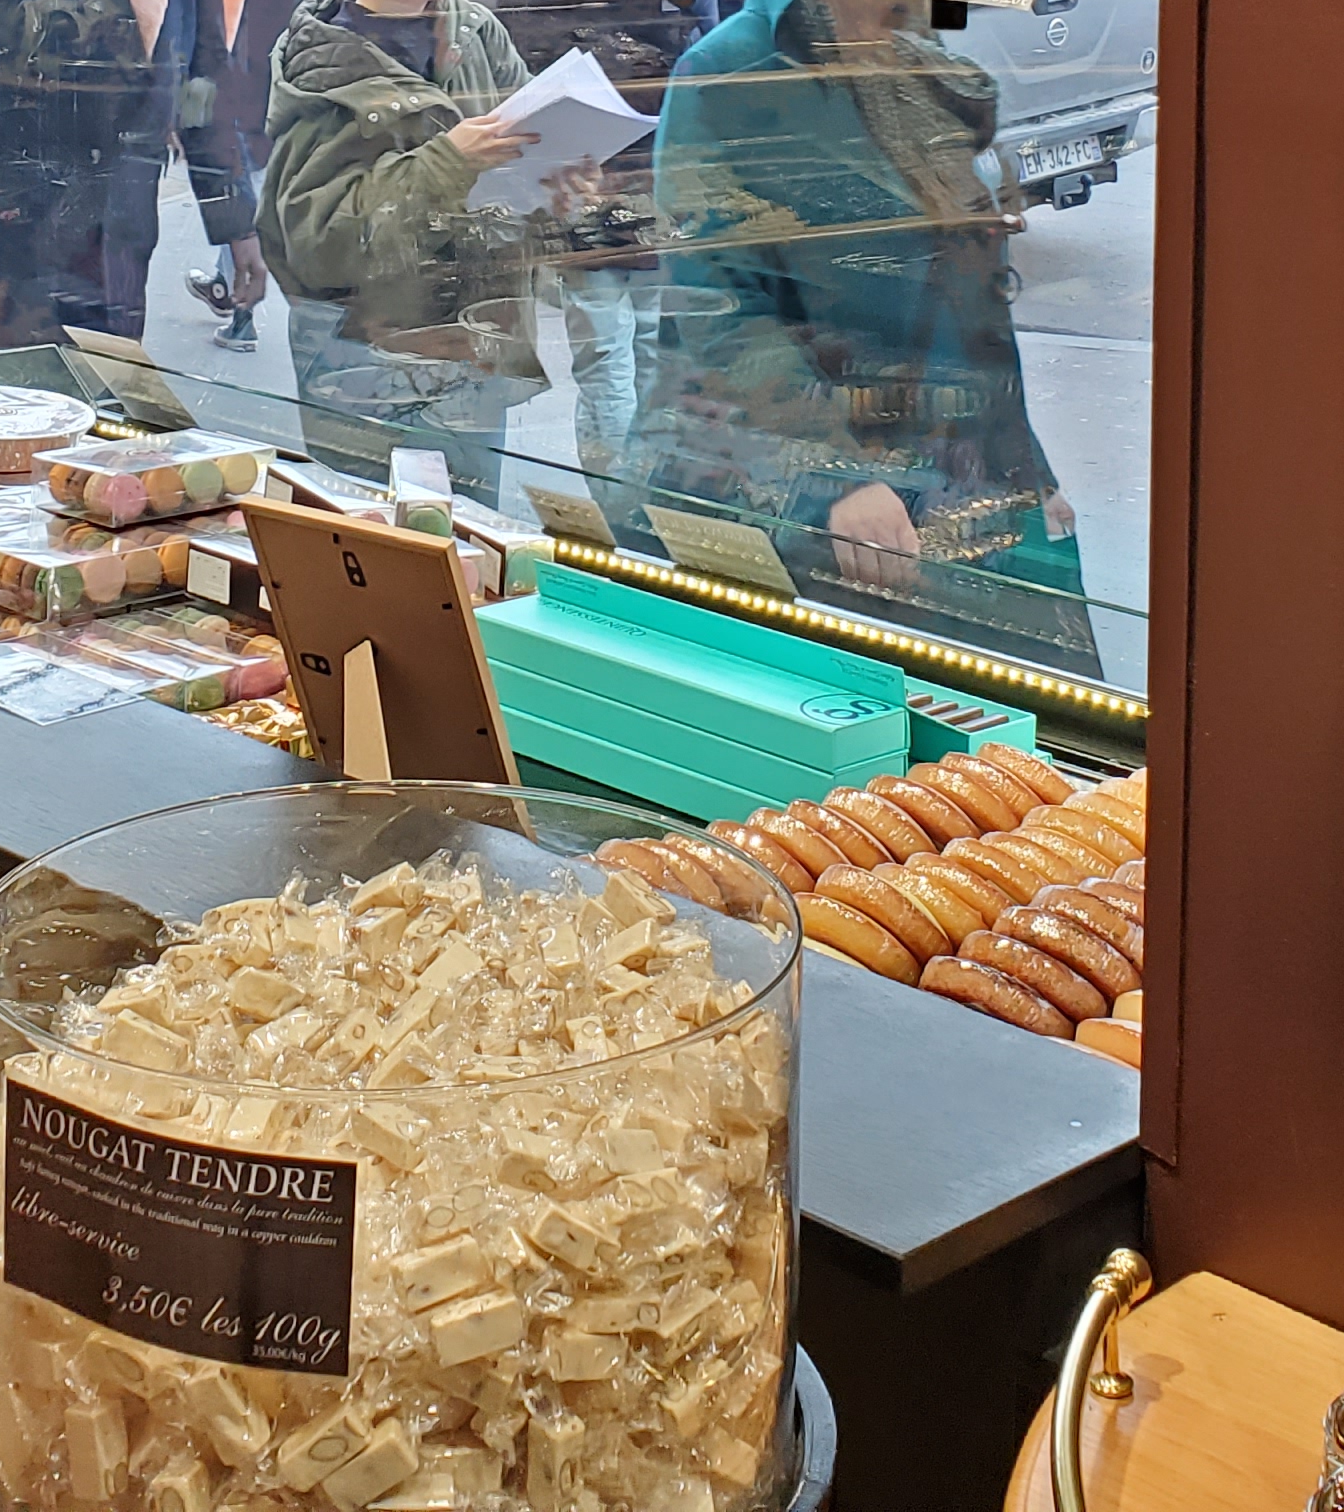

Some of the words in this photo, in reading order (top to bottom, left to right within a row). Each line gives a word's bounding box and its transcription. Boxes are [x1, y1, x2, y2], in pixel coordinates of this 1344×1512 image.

[19, 1098, 155, 1174] NOUGAT
[165, 1148, 335, 1203] TENDRE
[11, 1186, 140, 1261] libre-service
[140, 1180, 153, 1196] de
[197, 1194, 228, 1212] dans
[231, 1199, 245, 1215] la
[244, 1204, 279, 1222] pure
[282, 1207, 344, 1225] tradition
[251, 1230, 288, 1245] copper
[102, 1275, 193, 1327] 3,50€
[201, 1296, 242, 1337] les
[255, 1311, 342, 1365] 100g
